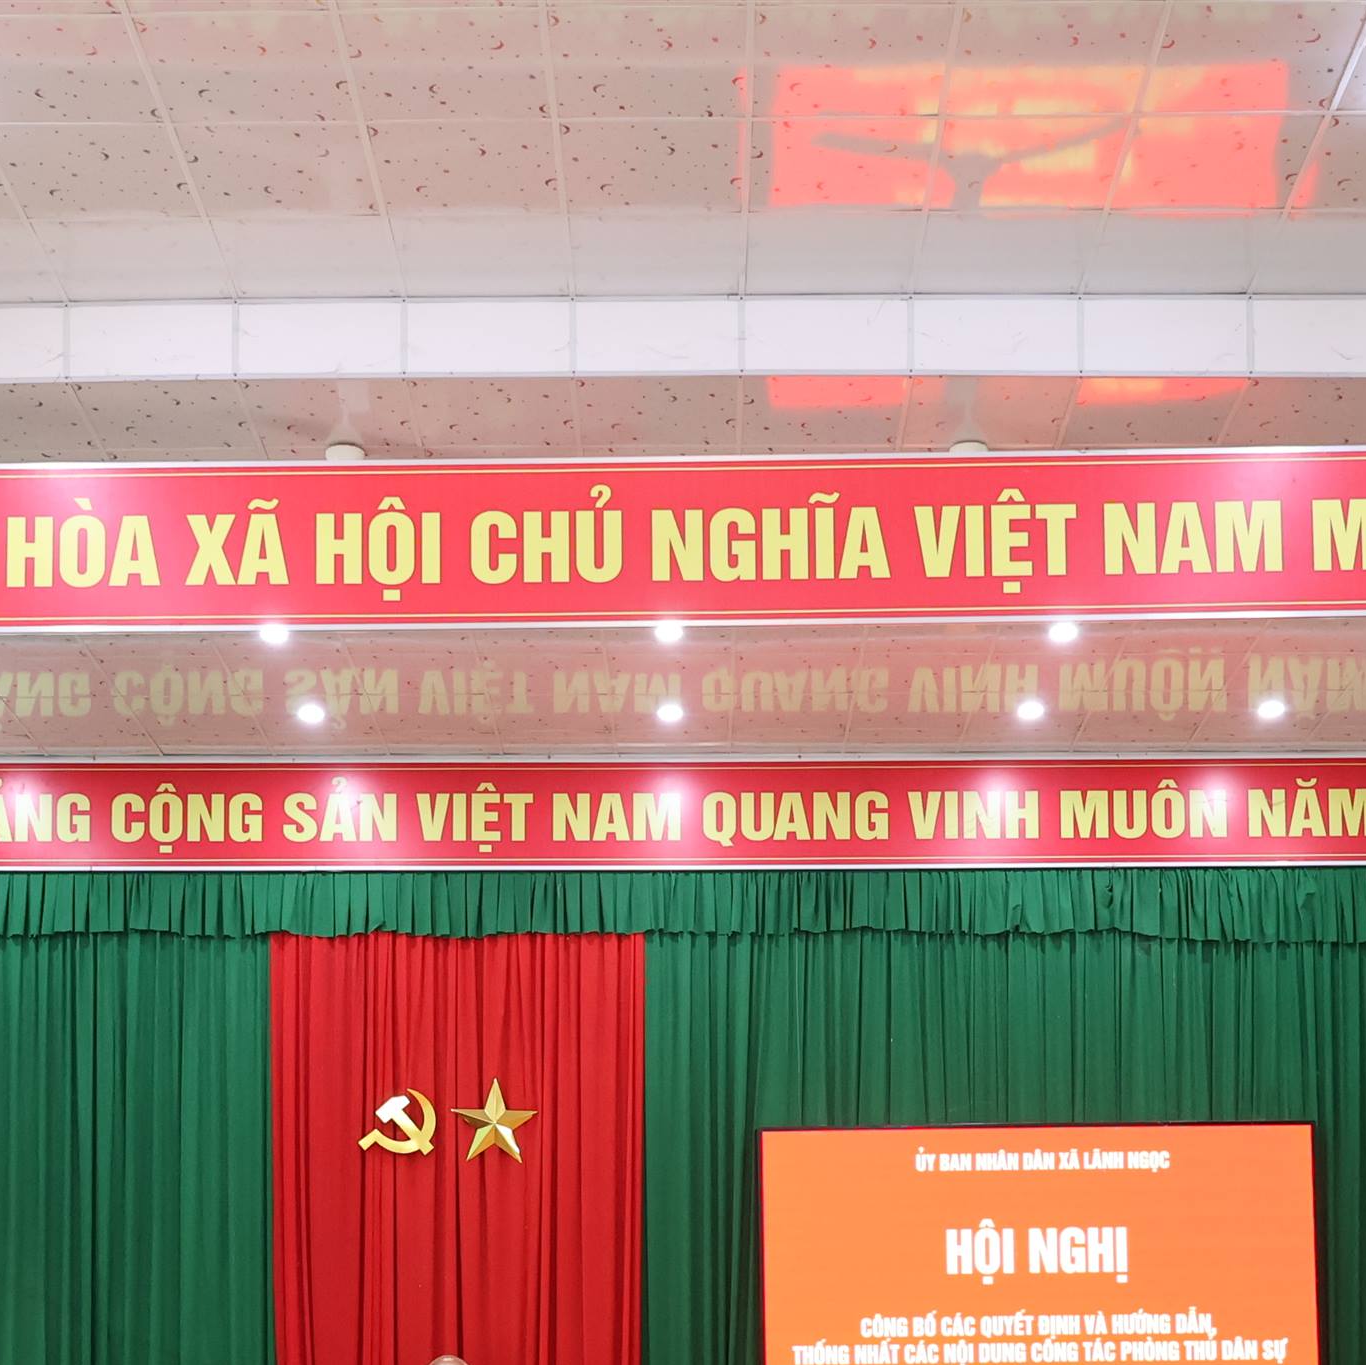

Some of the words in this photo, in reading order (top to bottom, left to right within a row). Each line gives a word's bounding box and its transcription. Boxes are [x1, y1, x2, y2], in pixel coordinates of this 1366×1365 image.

[6, 497, 161, 588] HÒA
[185, 498, 289, 586] XÃ
[315, 496, 441, 603] HỘI
[470, 484, 623, 585] CHỦ
[651, 491, 891, 582] NGHĨA
[913, 488, 1077, 594] VIỆT
[1103, 499, 1283, 575] NAM
[111, 783, 263, 854] CỘNG
[282, 775, 398, 843] SẢN
[416, 782, 534, 853] VIỆT
[552, 795, 684, 842] NAM
[702, 790, 889, 847] QUANG
[907, 777, 1040, 840] VINH
[1060, 778, 1228, 839] MUÔN
[914, 1146, 937, 1172] ỦY
[938, 1153, 973, 1172] BAN
[974, 1149, 1020, 1171] NHÂN
[1021, 1148, 1056, 1171] DÂN
[1058, 1148, 1081, 1170] XÃ
[1082, 1148, 1125, 1170] LÃNH
[1127, 1150, 1171, 1173] NGỌC
[945, 1218, 1015, 1286] HỘI
[1027, 1226, 1129, 1284] NGHỊ
[859, 1313, 910, 1337] CÔNG
[912, 1310, 938, 1337] BỐ
[939, 1312, 977, 1337] CÁC
[979, 1309, 1035, 1337] QUYẾT
[1037, 1314, 1082, 1337] ĐỊNH
[1082, 1310, 1108, 1337] VÀ
[1110, 1308, 1172, 1337] HƯỚNG
[1174, 1307, 1218, 1337] DẪN,
[791, 1338, 851, 1365] THỐNG
[852, 1337, 901, 1365] NHẤT
[903, 1339, 940, 1365] CÁC
[977, 1342, 1028, 1364] DUNG
[1030, 1337, 1080, 1363] CÔNG
[1082, 1337, 1117, 1362] TÁC
[1119, 1337, 1181, 1362] PHÒNG
[1184, 1337, 1218, 1361] THỦ
[1220, 1337, 1259, 1361] DÂN
[1261, 1337, 1287, 1365] SỰ
